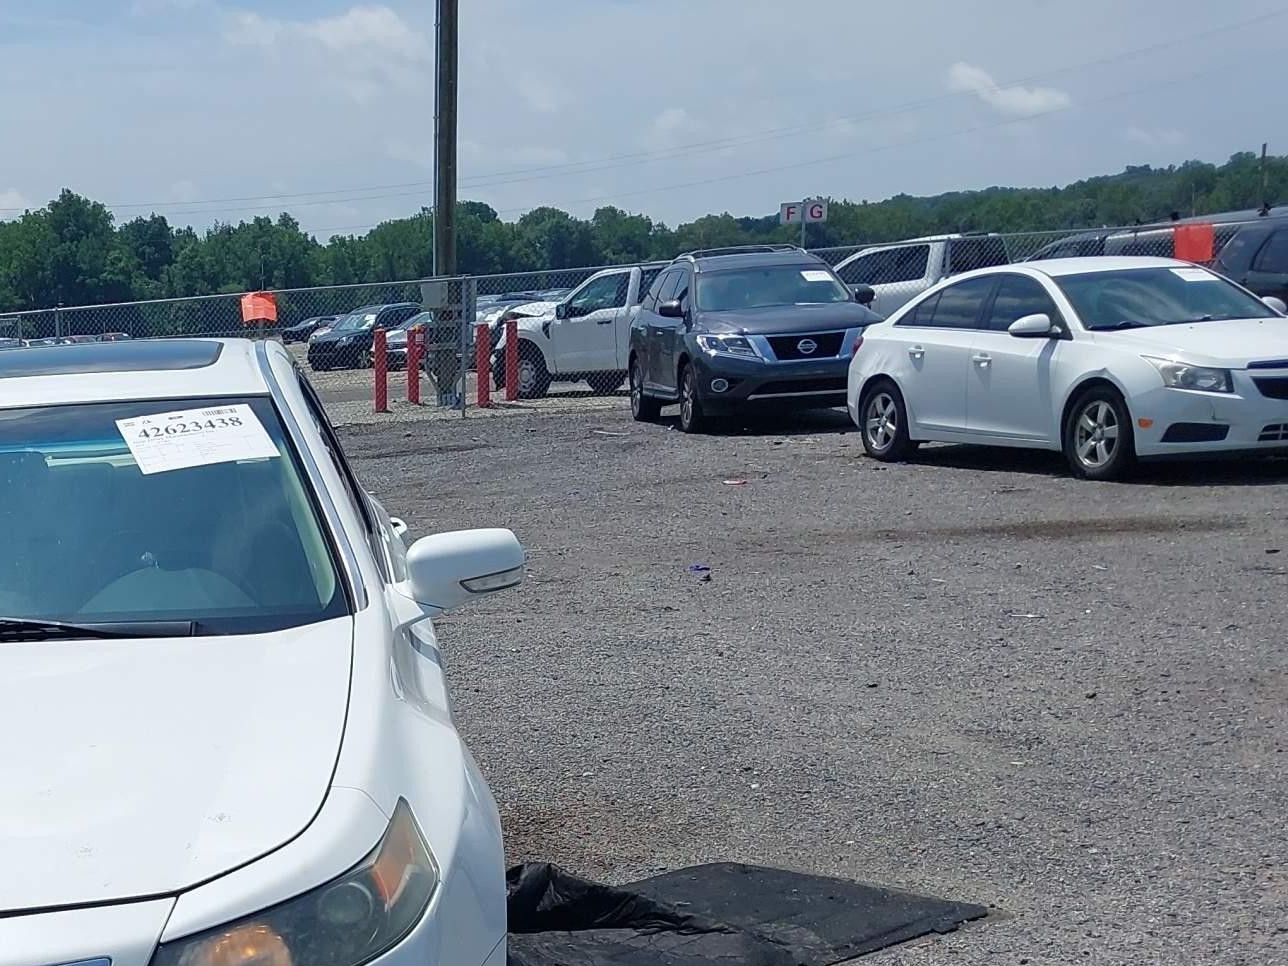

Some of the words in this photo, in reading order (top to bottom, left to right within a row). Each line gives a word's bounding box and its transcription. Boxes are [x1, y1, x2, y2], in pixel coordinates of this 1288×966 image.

[786, 206, 796, 221] F
[809, 204, 824, 219] G
[138, 416, 243, 438] 42623438
